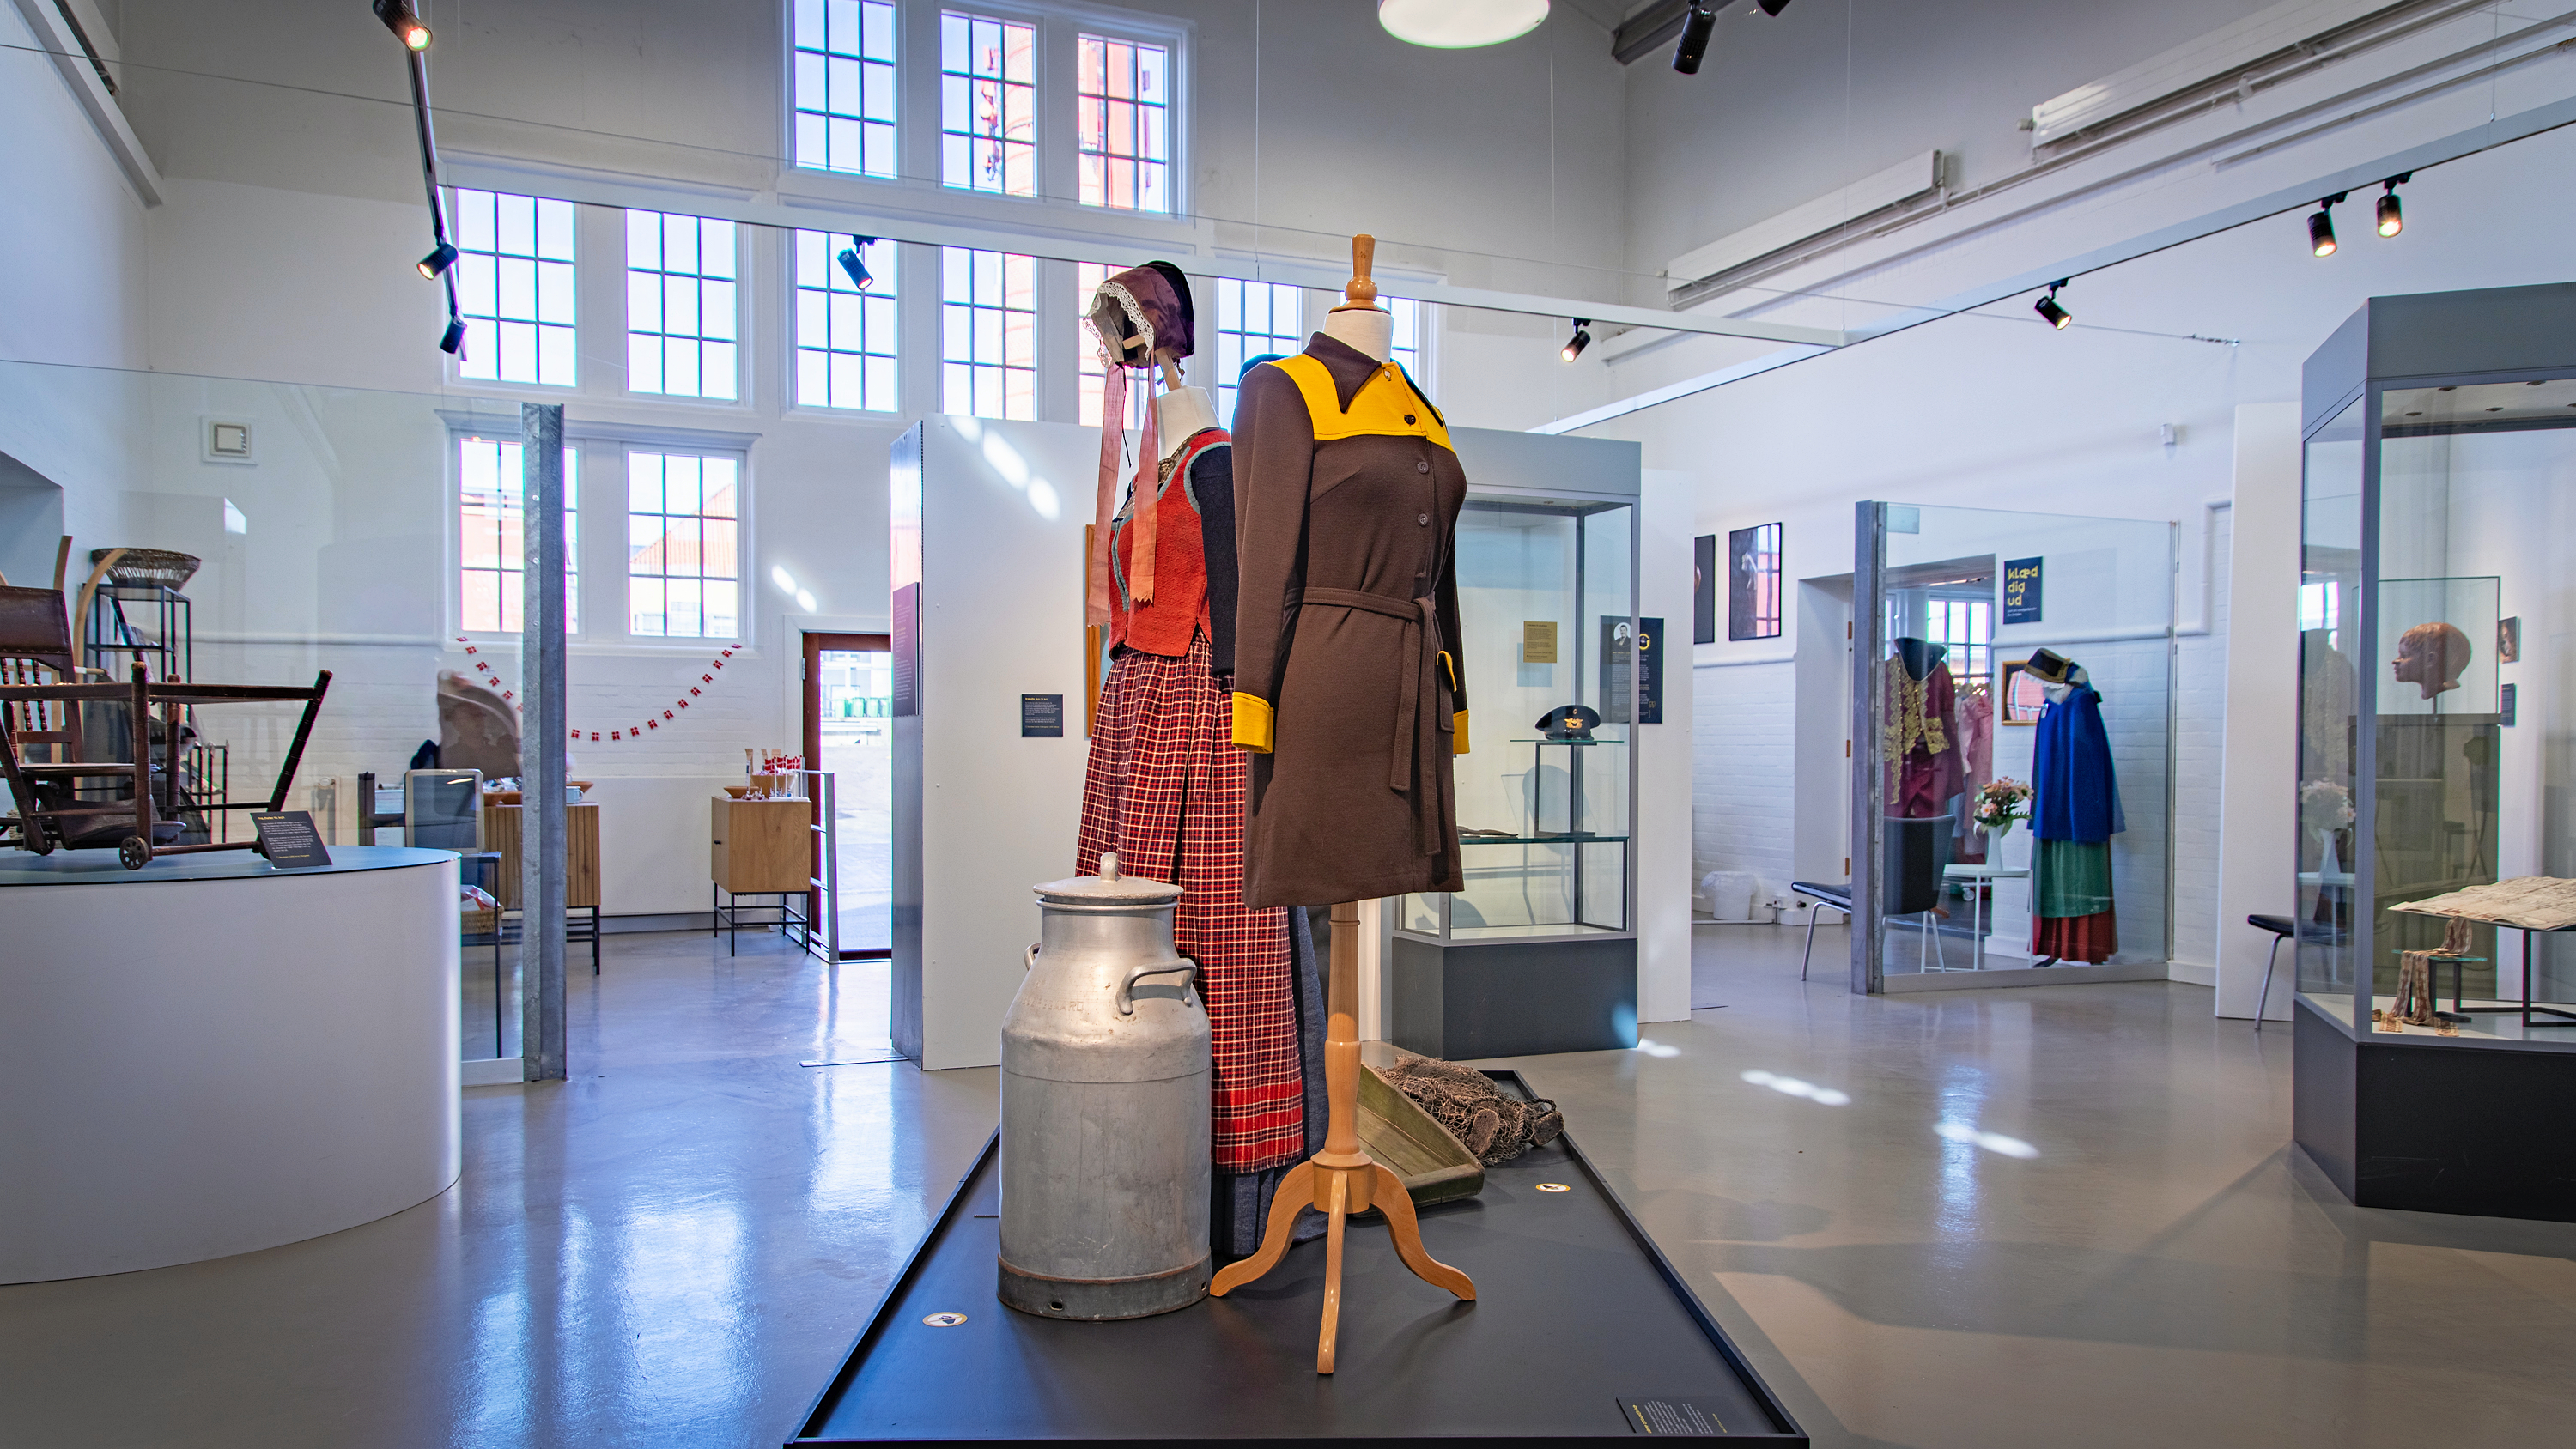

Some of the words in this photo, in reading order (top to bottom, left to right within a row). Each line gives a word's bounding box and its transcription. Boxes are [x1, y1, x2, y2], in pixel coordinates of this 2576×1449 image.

[2008, 565, 2038, 580] klæd
[2008, 581, 2026, 593] dig
[2008, 594, 2022, 606] ud
